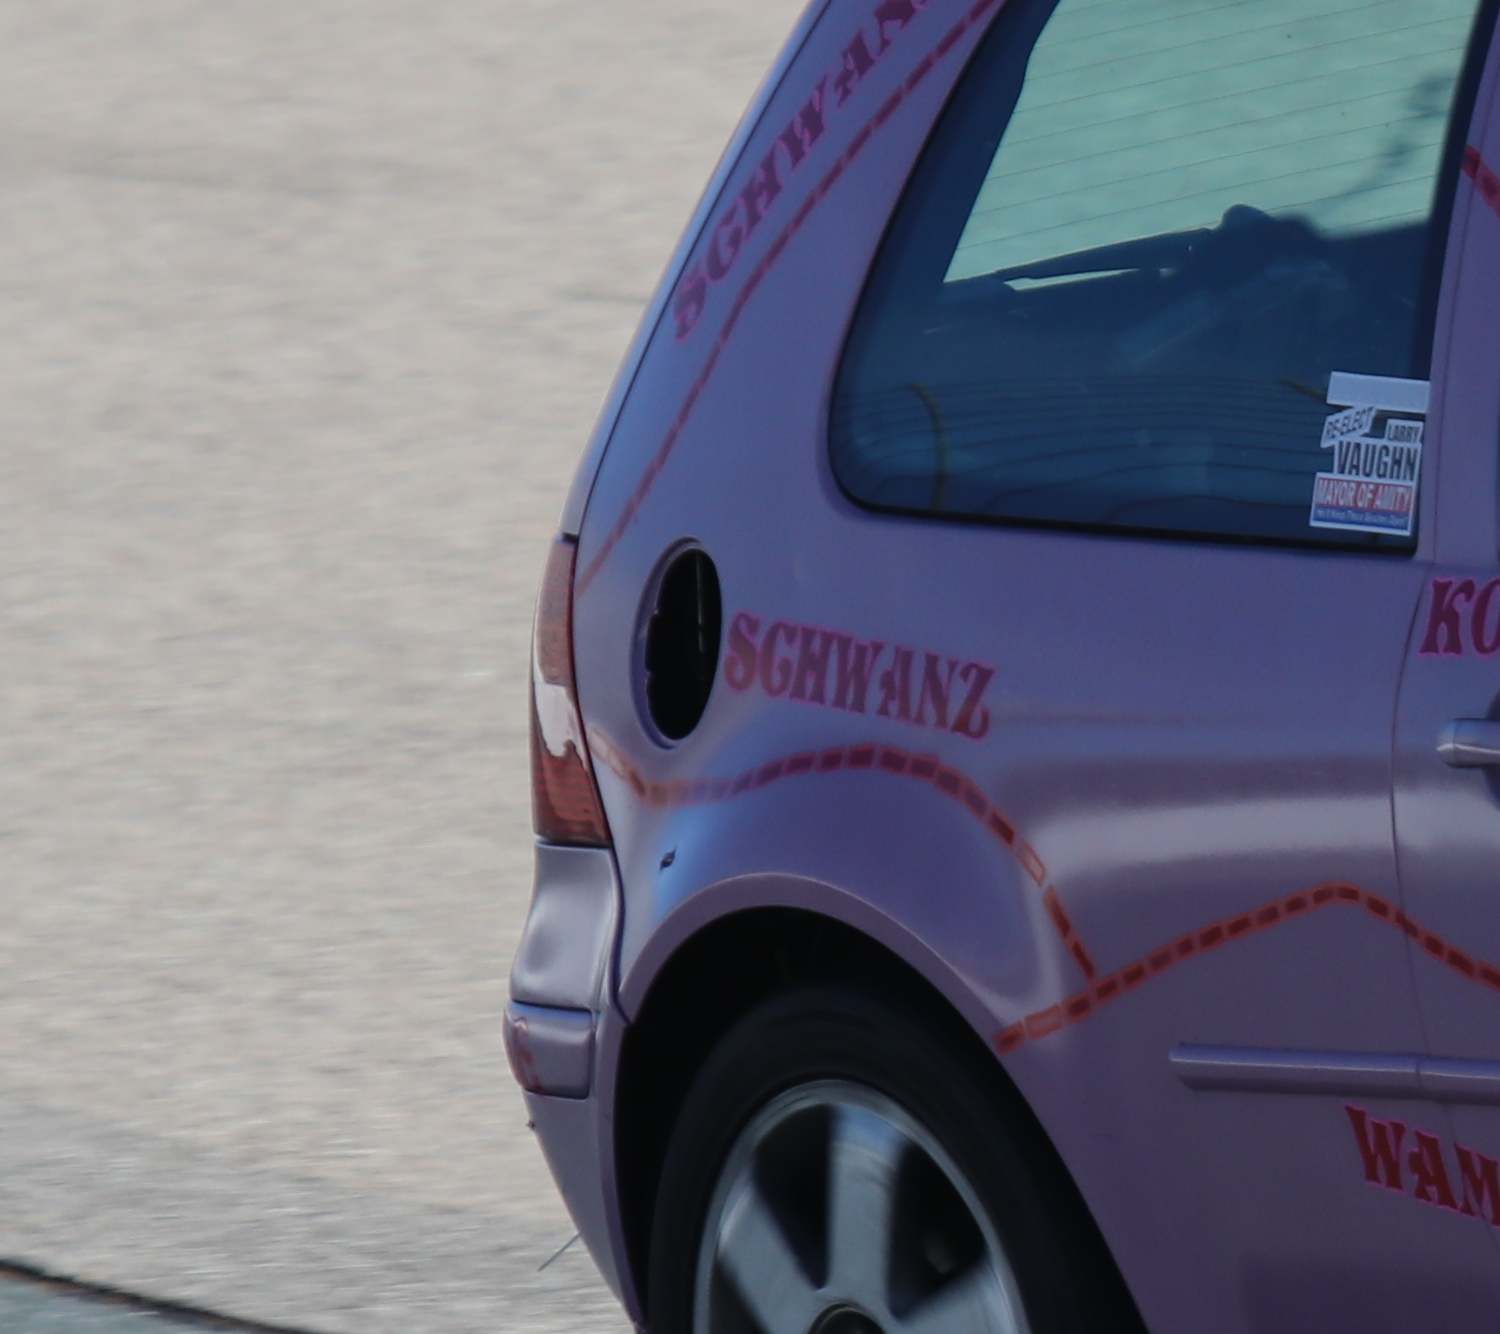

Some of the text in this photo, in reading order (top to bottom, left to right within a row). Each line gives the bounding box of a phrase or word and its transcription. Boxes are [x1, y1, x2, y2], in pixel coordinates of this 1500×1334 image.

[1387, 423, 1421, 443] LARRY
[1337, 440, 1418, 482] VAUGHN
[1316, 478, 1355, 508] MAYOR
[1357, 483, 1375, 509] OF
[723, 610, 995, 740] SCHWANZ
